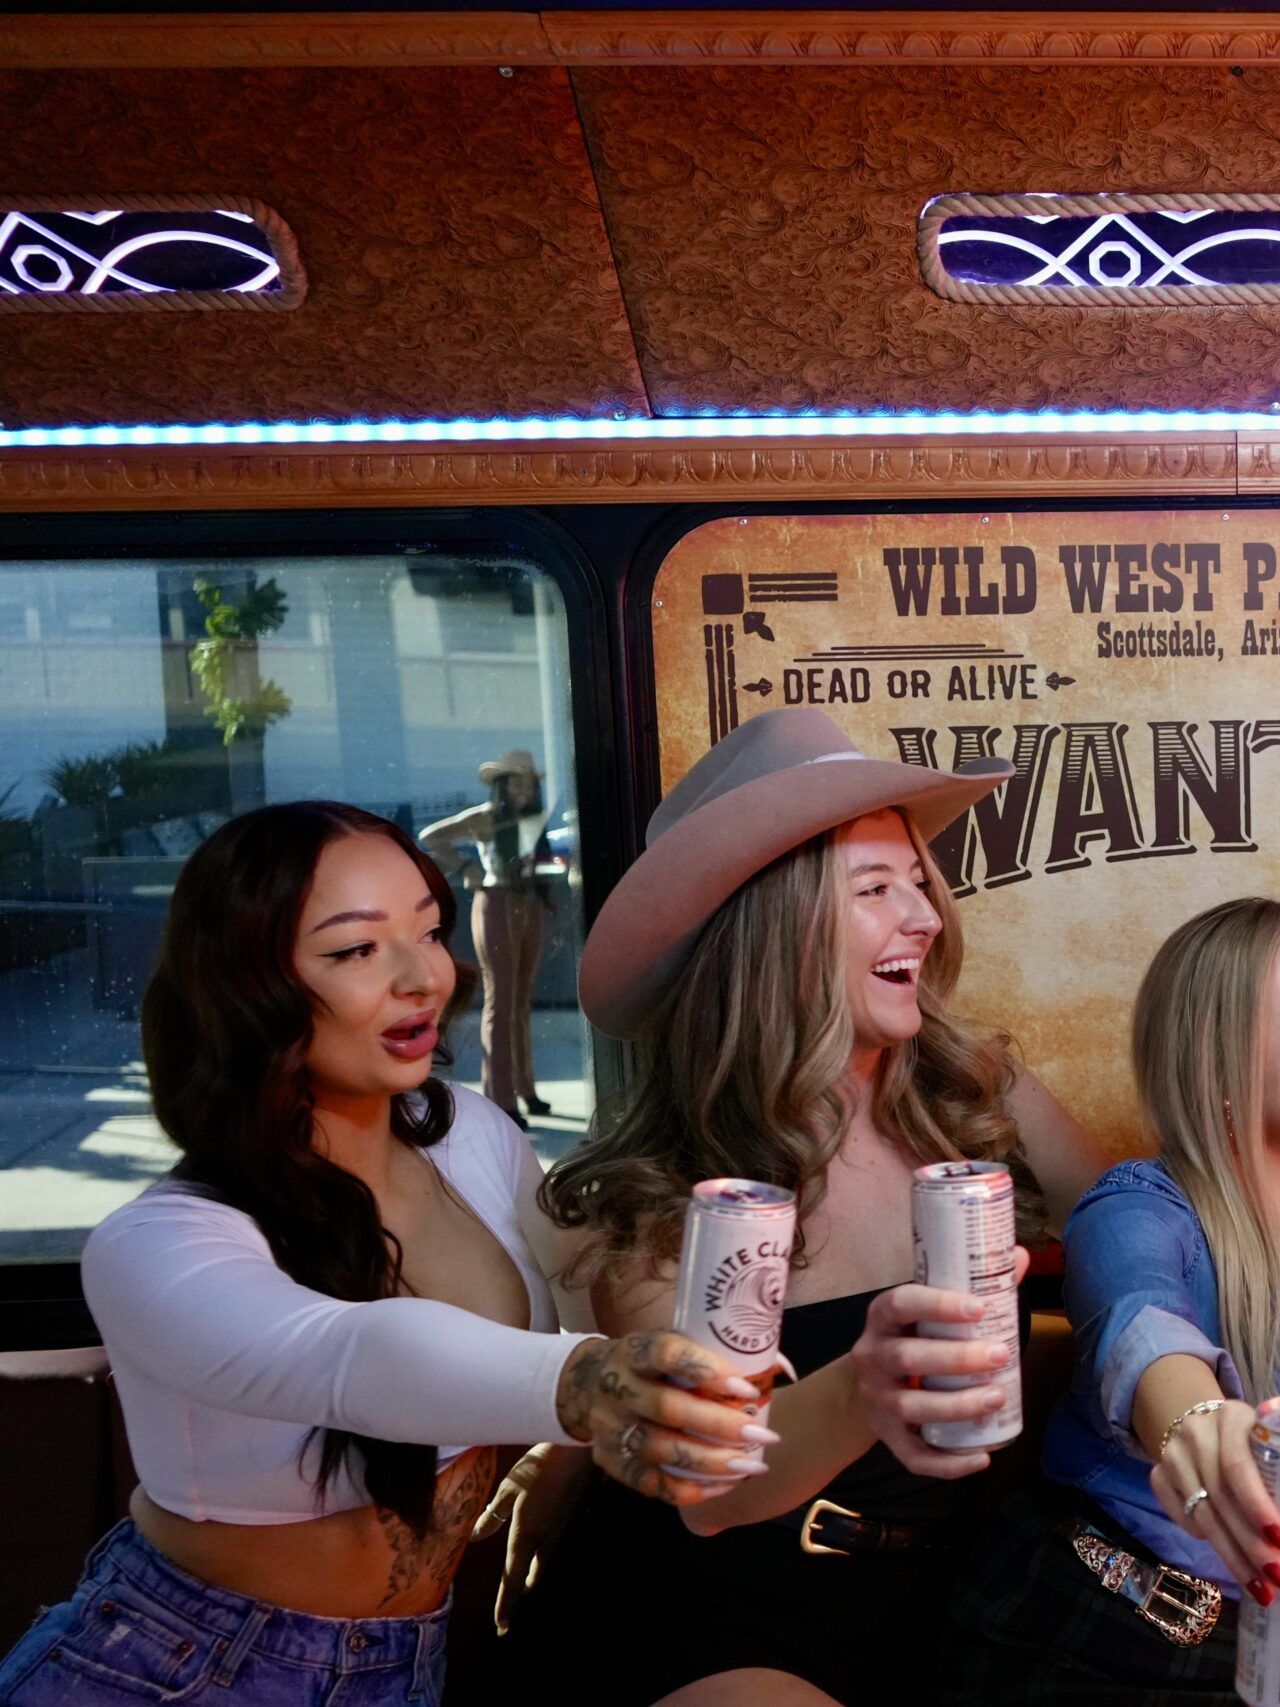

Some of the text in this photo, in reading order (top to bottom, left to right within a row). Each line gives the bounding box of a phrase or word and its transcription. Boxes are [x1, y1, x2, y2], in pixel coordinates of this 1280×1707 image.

[883, 545, 1038, 617] WILD
[1059, 542, 1221, 614] WEST
[1096, 620, 1224, 660] Scottsdale,
[783, 663, 1039, 705] DEAD OR ALIVE
[705, 1241, 790, 1312] WHITE CLA
[720, 1325, 761, 1348] HARD
